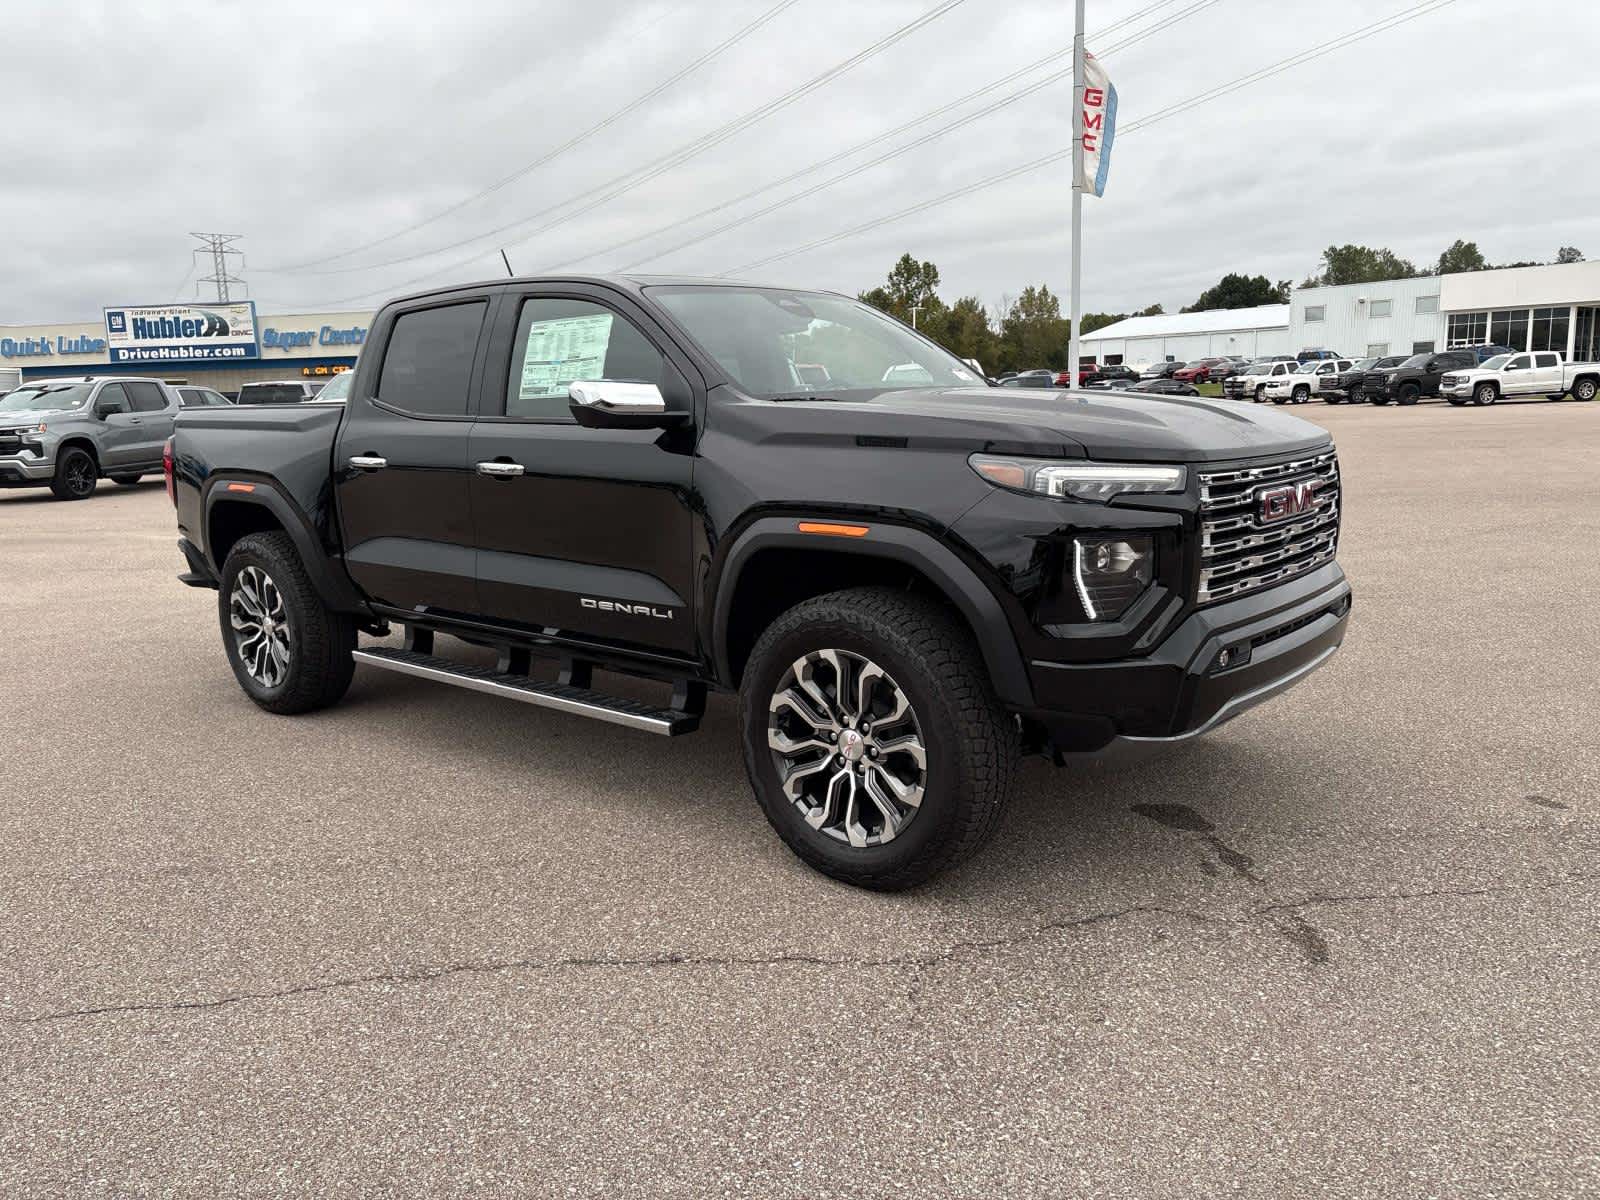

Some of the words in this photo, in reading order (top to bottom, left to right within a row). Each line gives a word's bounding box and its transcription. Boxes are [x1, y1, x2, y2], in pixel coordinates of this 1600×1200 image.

[1082, 87, 1103, 152] GMC
[111, 316, 123, 328] GM
[132, 316, 205, 340] Hubler
[0, 336, 54, 358] Quick
[58, 335, 106, 354] Lube
[263, 328, 316, 352] Super
[118, 347, 245, 361] DriveHubler.com
[1260, 480, 1326, 522] GMC
[580, 598, 673, 619] DENALI
